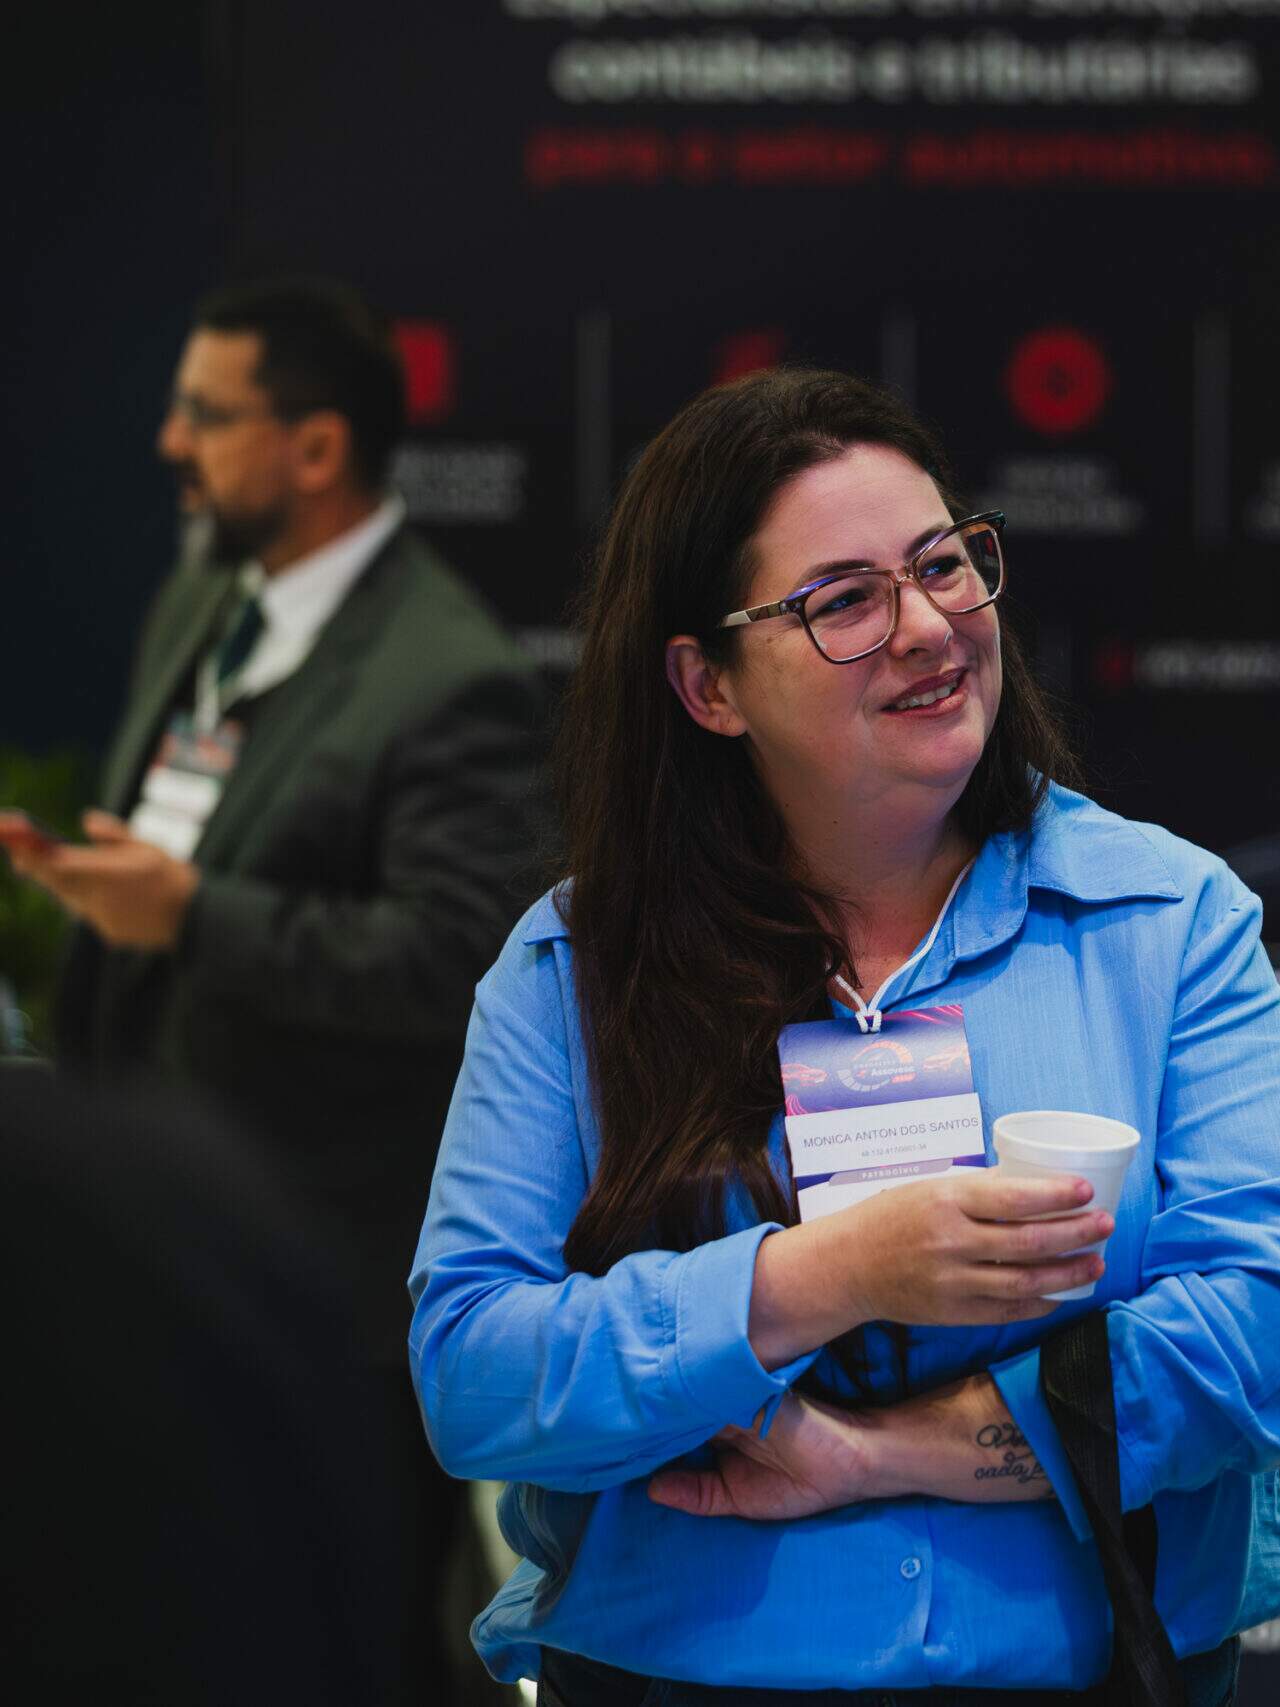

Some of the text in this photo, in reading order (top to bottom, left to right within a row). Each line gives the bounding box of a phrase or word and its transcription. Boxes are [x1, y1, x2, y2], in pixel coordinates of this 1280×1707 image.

[803, 1117, 979, 1148] MONICA ANTON DOS SANTOS
